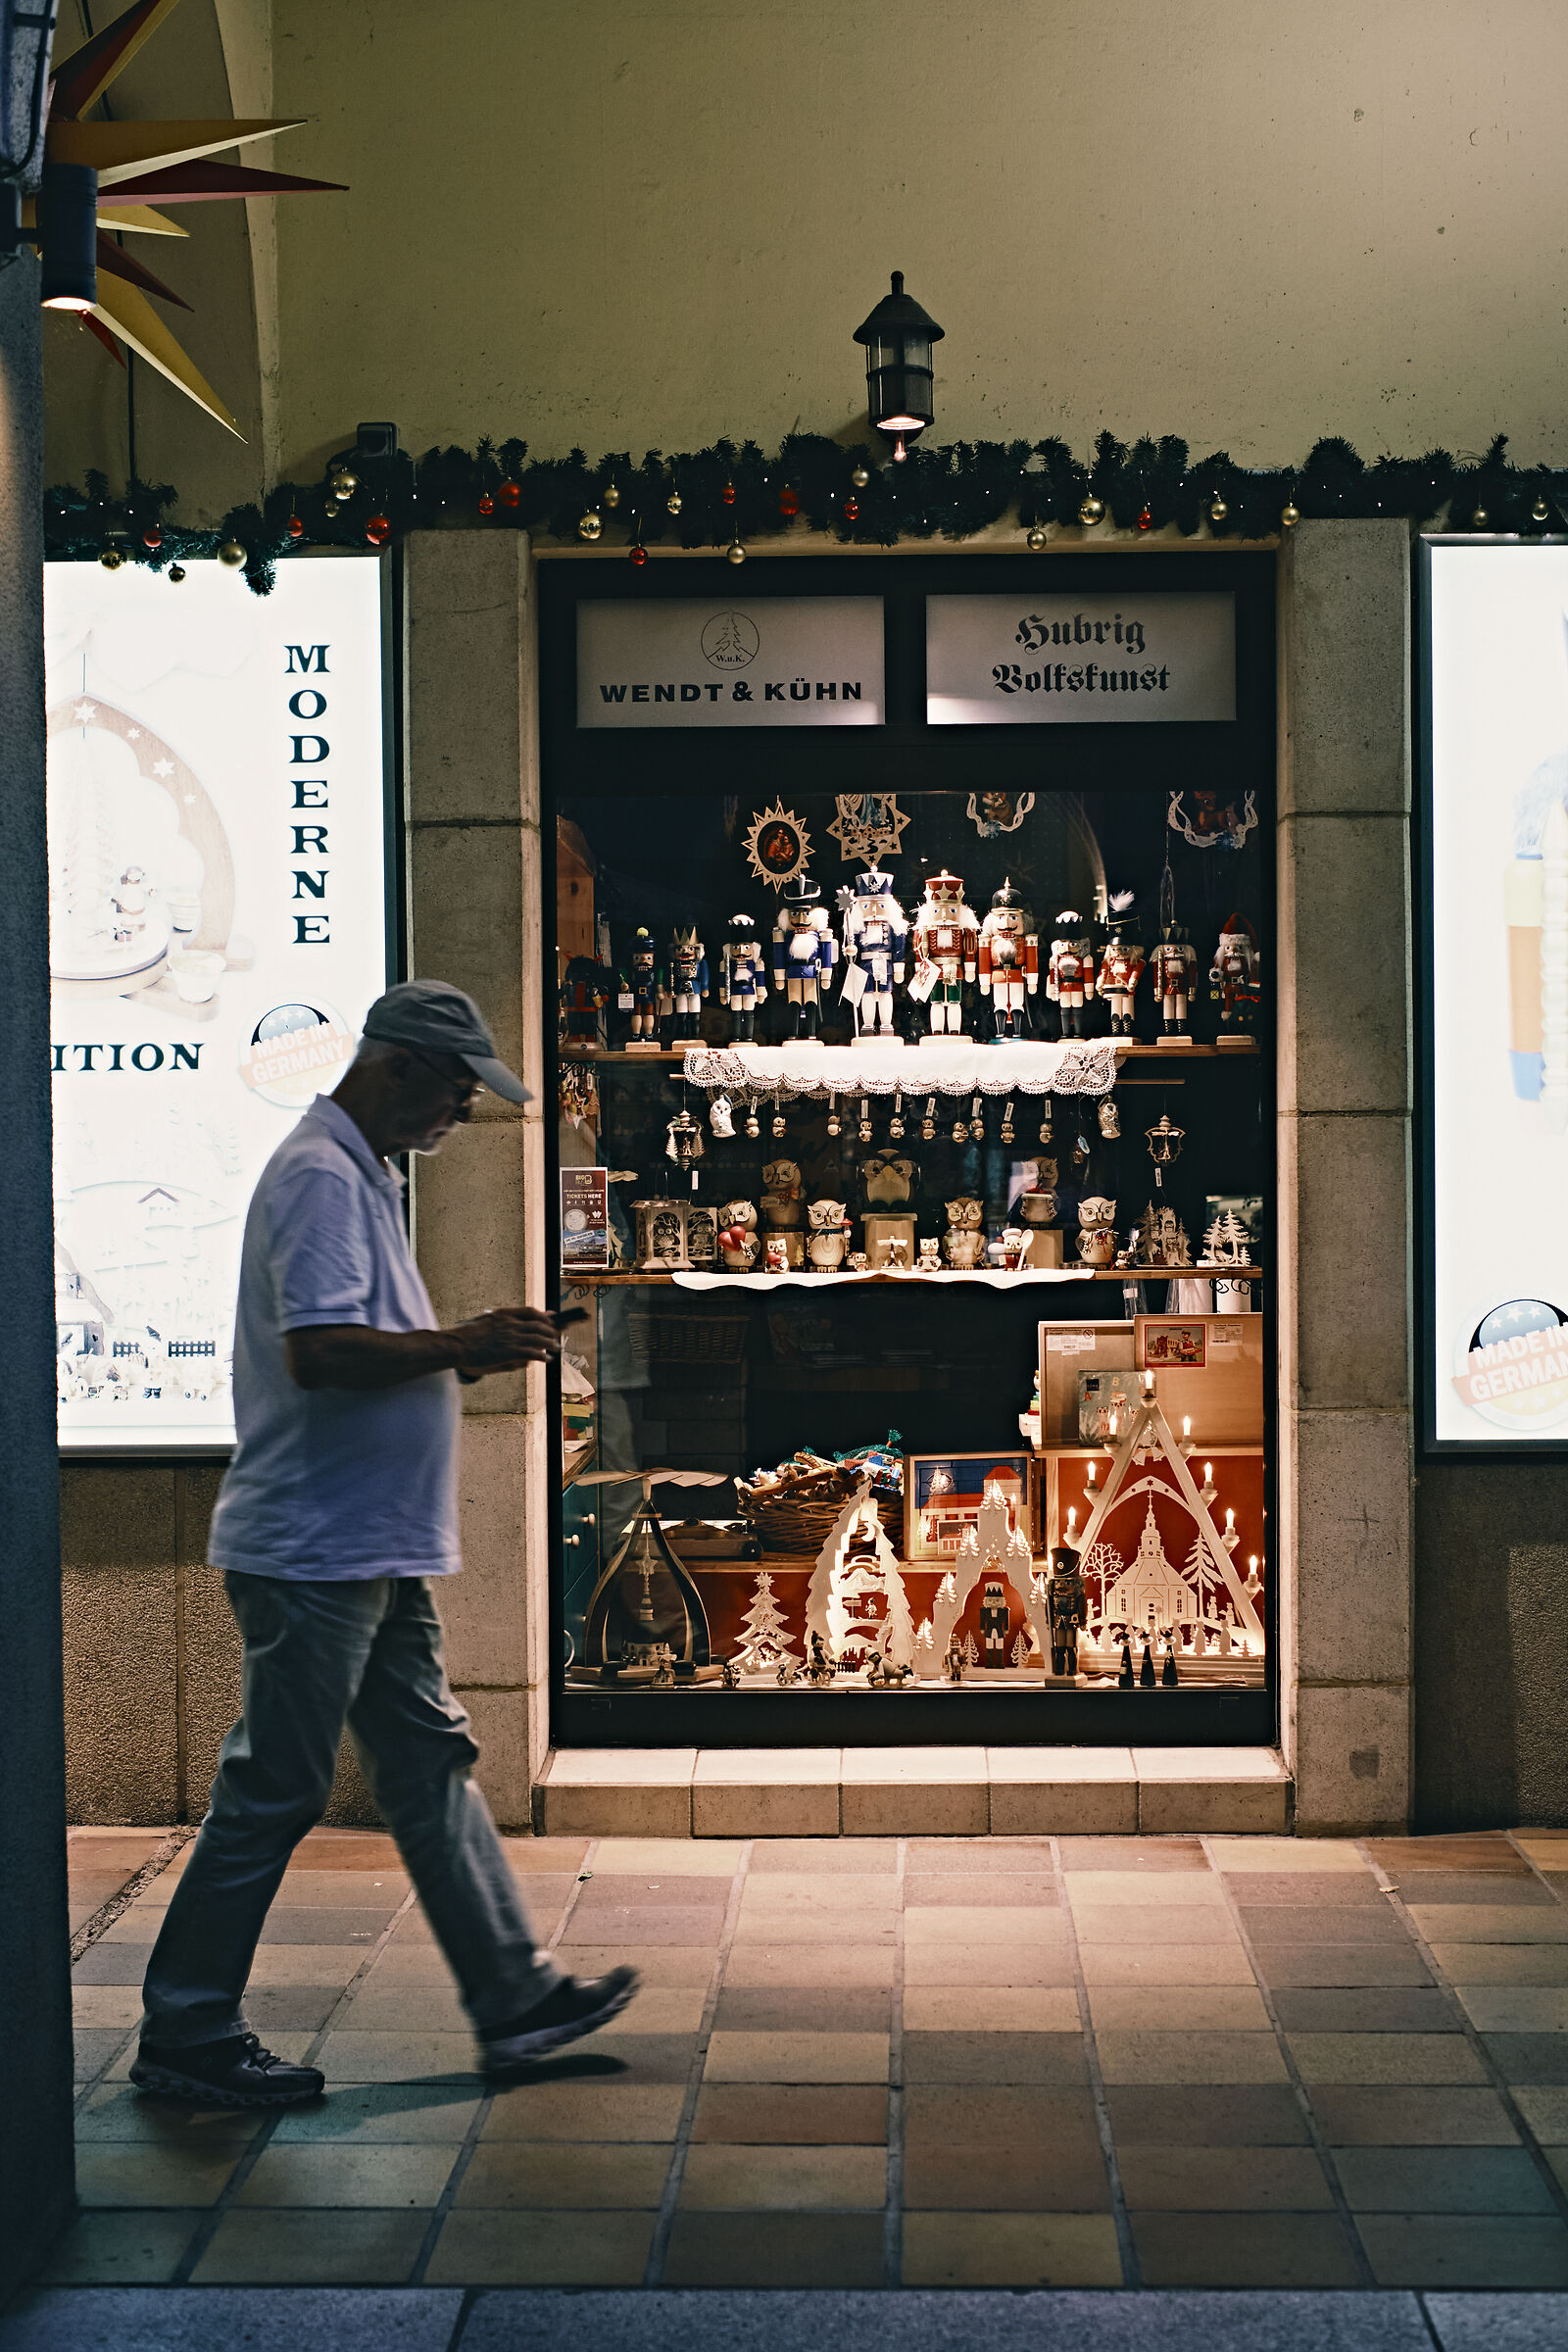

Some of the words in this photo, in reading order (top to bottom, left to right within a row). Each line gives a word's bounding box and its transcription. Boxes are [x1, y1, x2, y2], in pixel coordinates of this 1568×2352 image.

[1015, 612, 1146, 656] Hubrig
[600, 683, 723, 704] WENDT
[732, 681, 754, 702] &
[765, 677, 861, 701] KÜHN
[991, 663, 1170, 694] Volkskunst
[284, 645, 330, 944] MODERNE
[253, 1028, 308, 1059] MADE
[308, 1020, 331, 1046] IN
[252, 1038, 347, 1084] GERMANY
[1473, 1330, 1542, 1369] MADE
